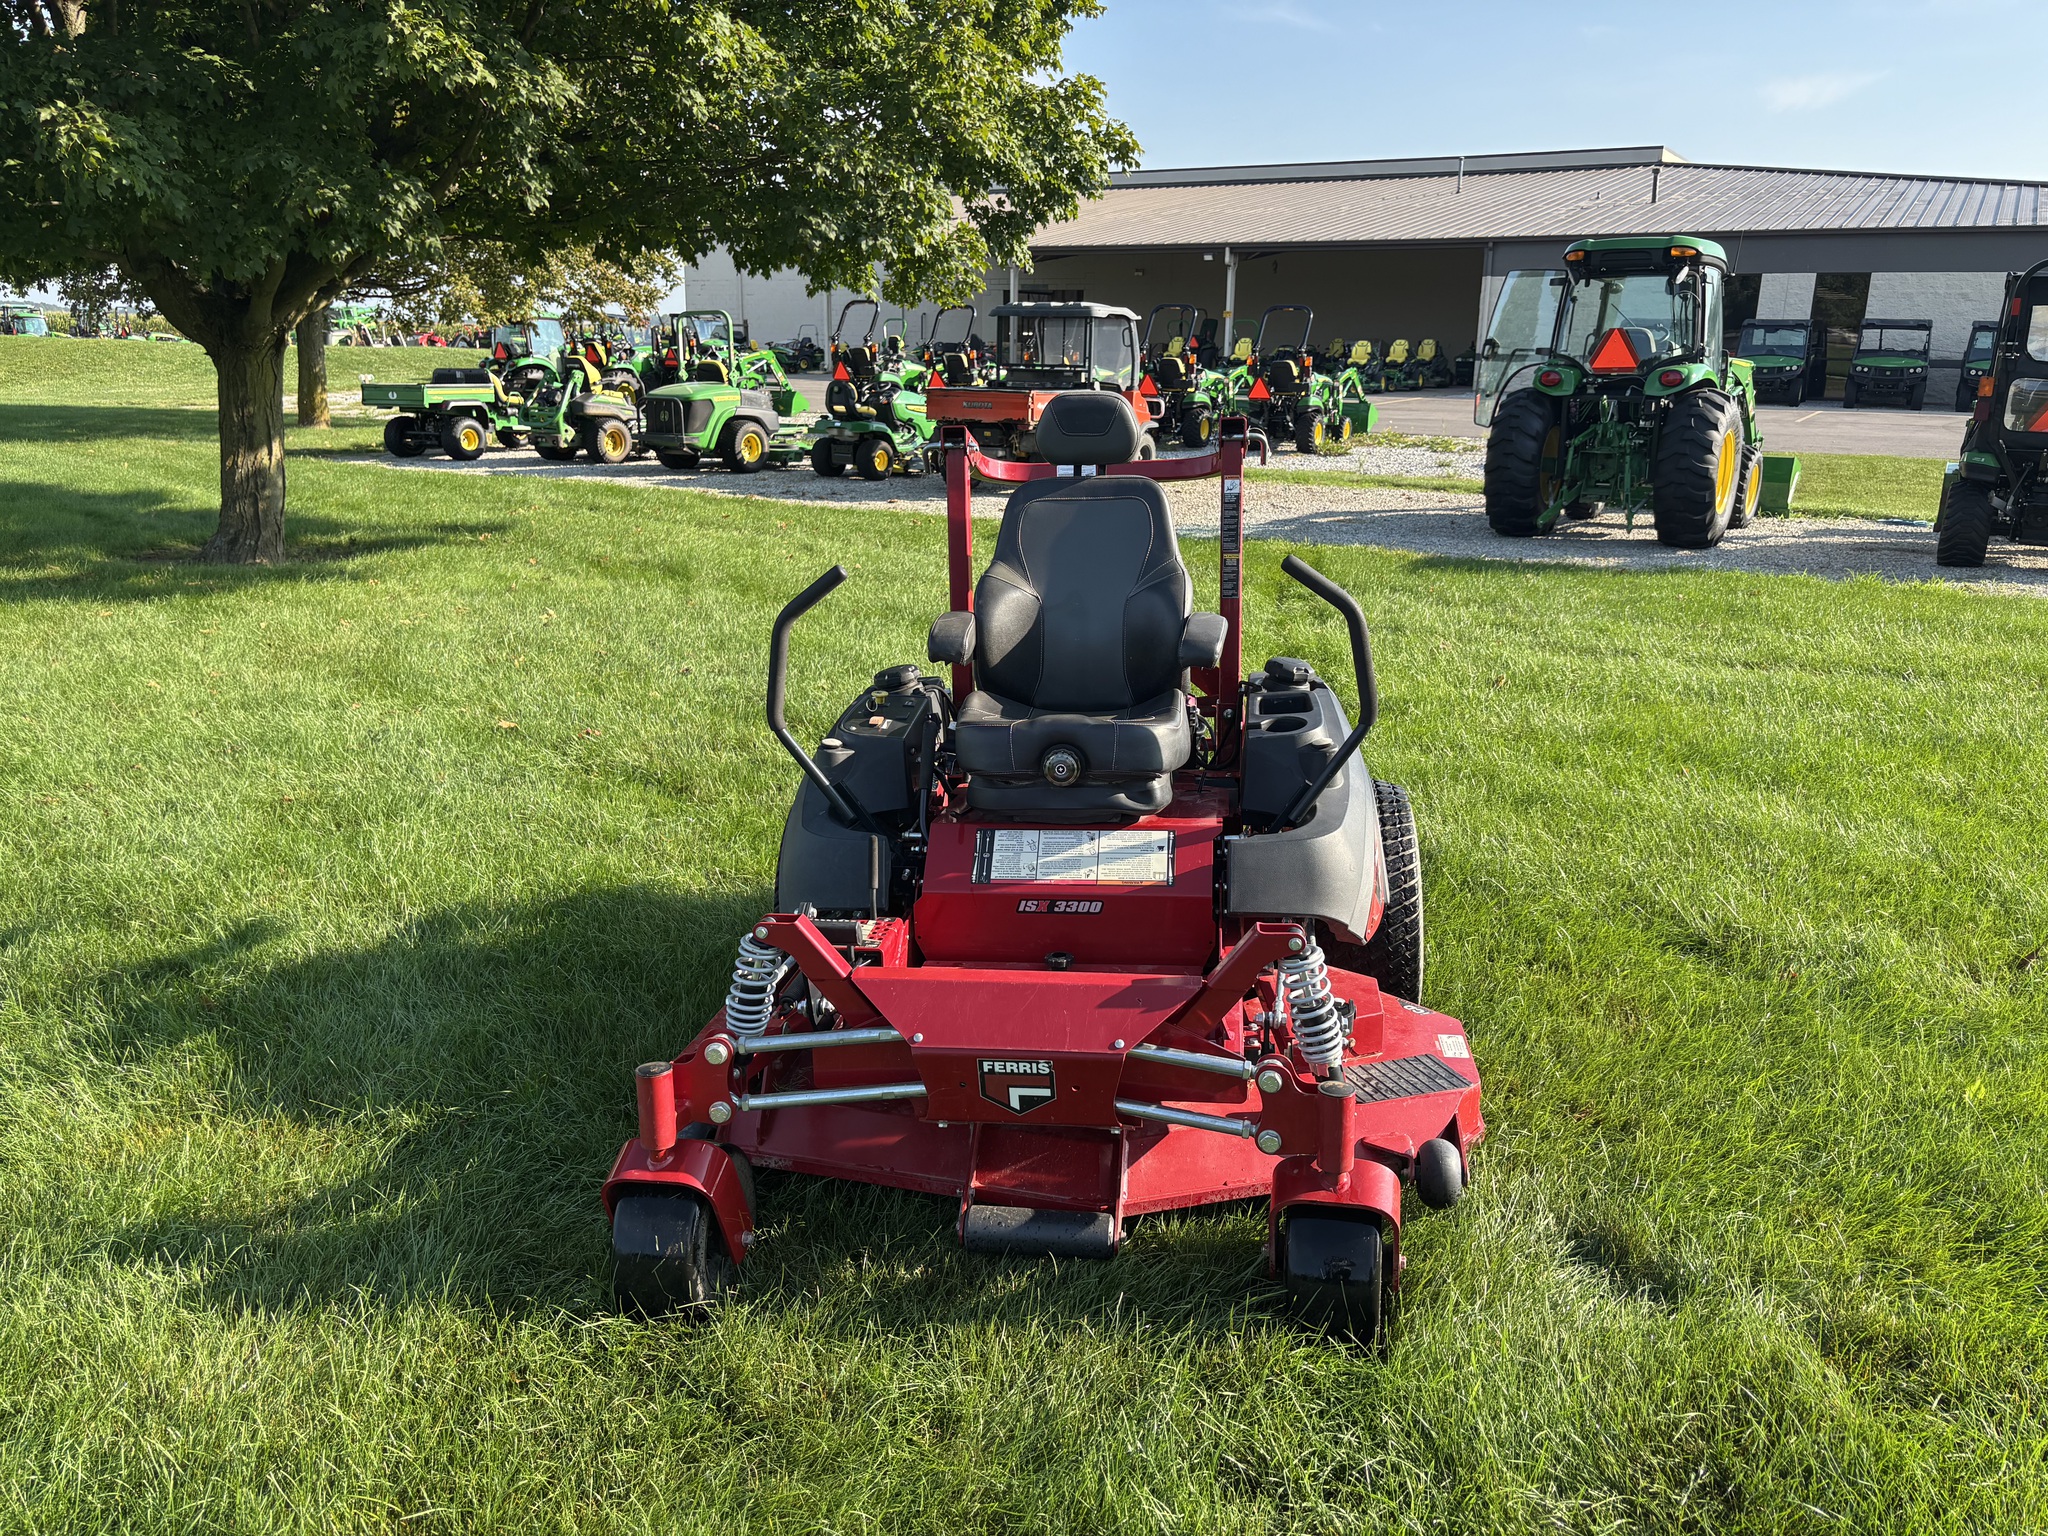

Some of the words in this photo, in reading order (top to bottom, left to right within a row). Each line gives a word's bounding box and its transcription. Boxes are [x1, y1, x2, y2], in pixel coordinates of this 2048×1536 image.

[962, 401, 992, 409] KUBOTA
[1018, 900, 1050, 912] ISX
[1054, 901, 1103, 913] 3300
[982, 1061, 1050, 1074] FERRIS
